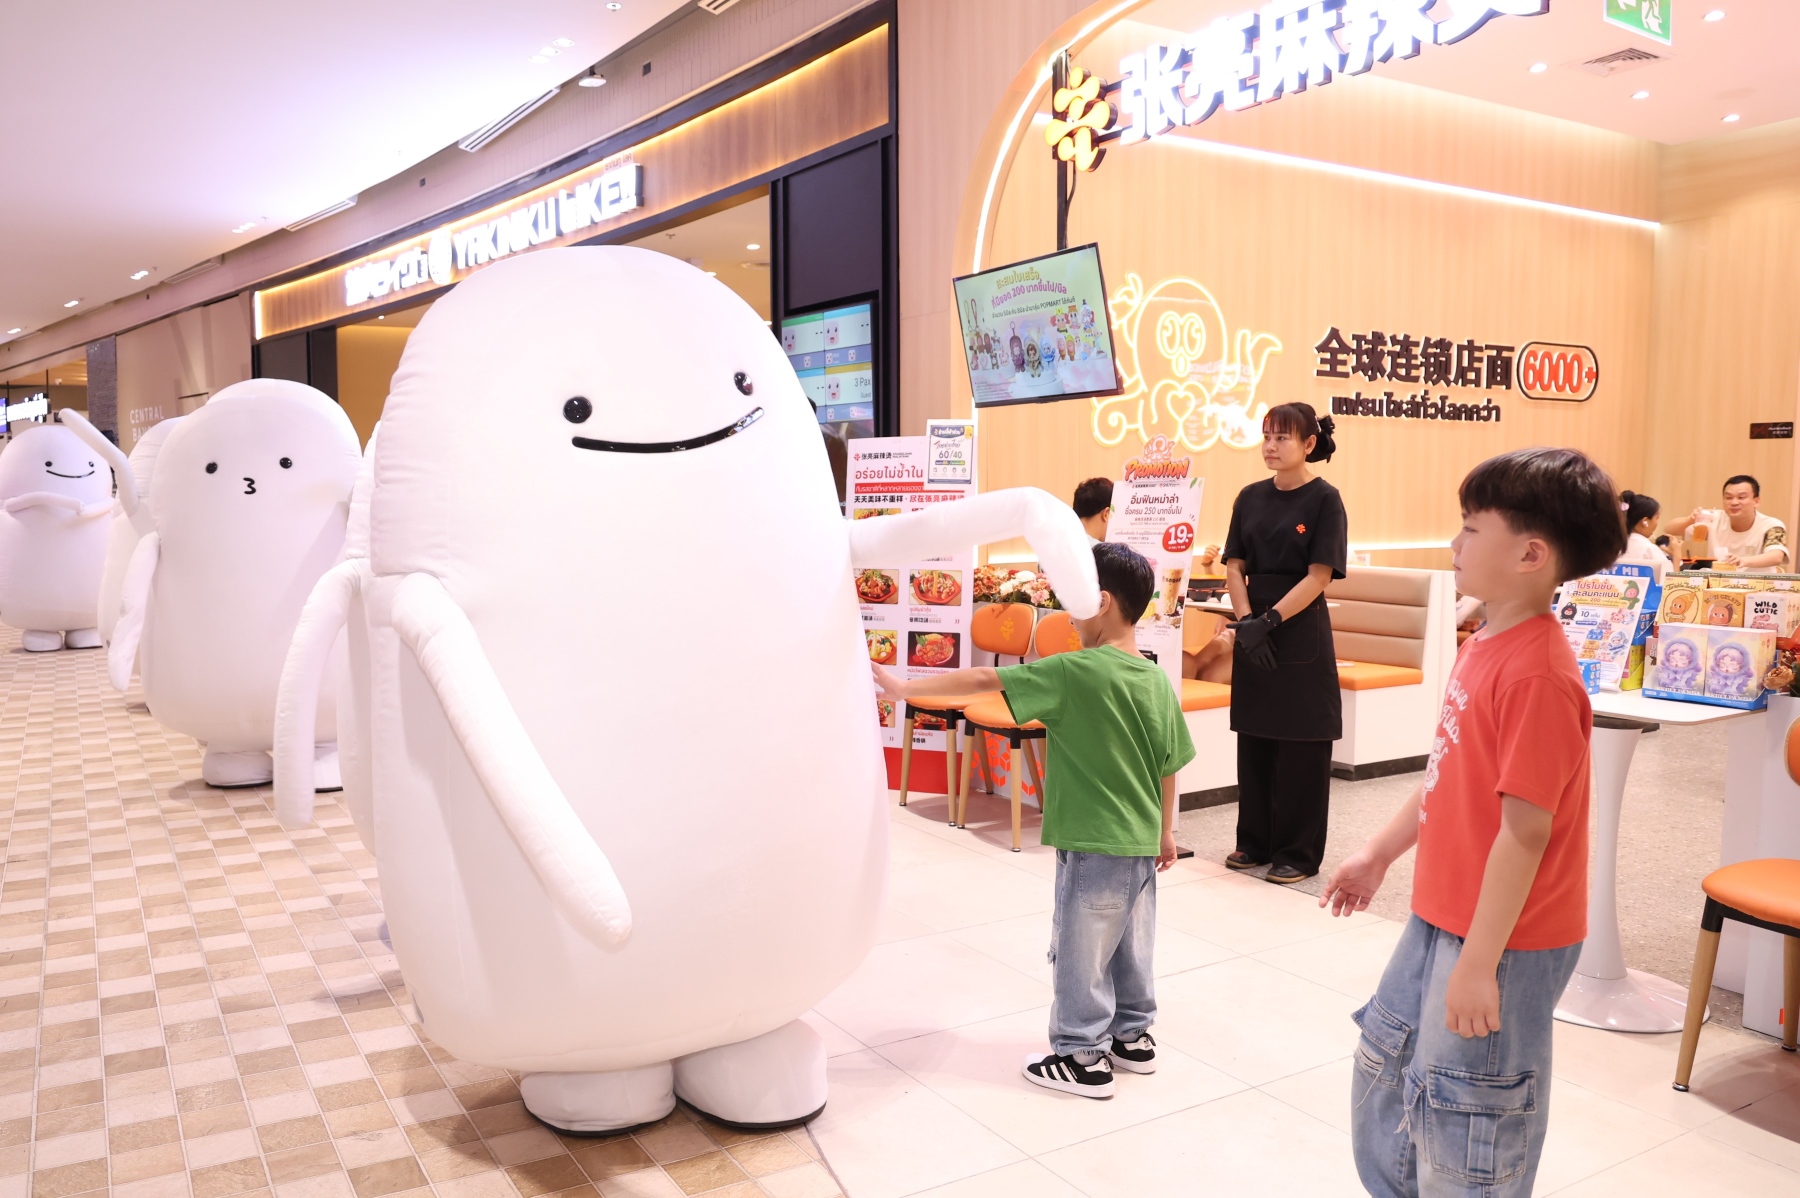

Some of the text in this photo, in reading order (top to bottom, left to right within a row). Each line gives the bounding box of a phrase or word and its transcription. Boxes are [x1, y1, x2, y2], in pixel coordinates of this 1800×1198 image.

[1012, 285, 1026, 297] 200
[1315, 327, 1515, 390] 全球连锁店面
[1522, 349, 1597, 394] 6000+
[854, 377, 871, 387] 3 Pax
[130, 405, 164, 424] CENTRAL
[938, 450, 962, 459] 60/40
[1125, 459, 1189, 481] PROMOTION
[854, 495, 904, 503] 天天美味不重样
[1144, 507, 1156, 515] 250
[1622, 566, 1639, 576] ME
[1577, 579, 1613, 590] โปรโมชั่น
[1720, 594, 1741, 606] GELATO
[1755, 601, 1777, 609] WILD
[1580, 610, 1589, 618] 10
